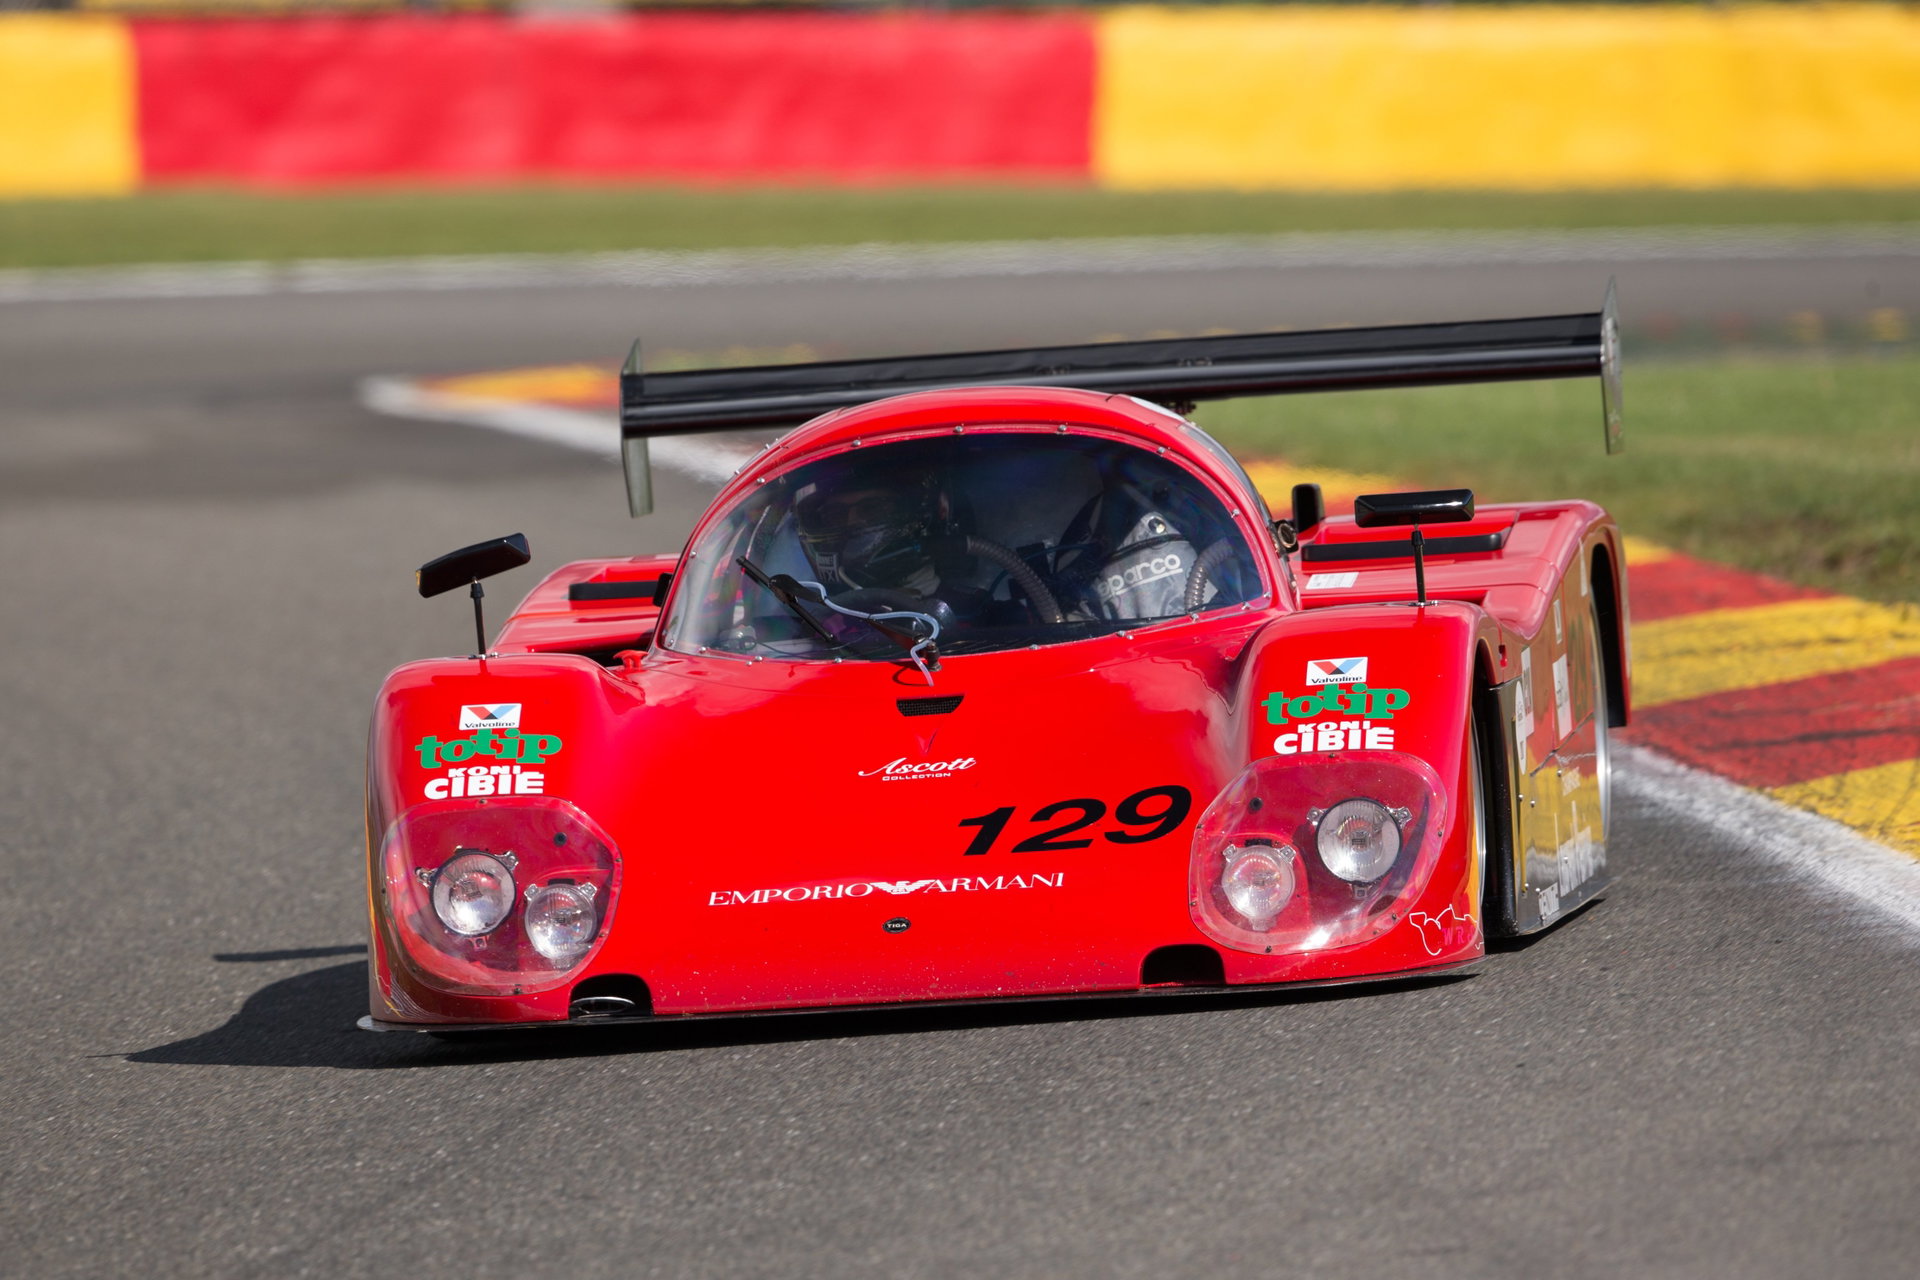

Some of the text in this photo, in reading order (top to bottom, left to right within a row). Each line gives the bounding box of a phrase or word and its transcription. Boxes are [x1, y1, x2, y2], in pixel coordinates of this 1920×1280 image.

[1311, 676, 1363, 684] Valvoline
[1261, 683, 1411, 724] totip
[464, 721, 516, 729] Valvoline
[1297, 720, 1371, 734] KONI
[414, 728, 563, 769] totip
[448, 764, 521, 778] KONI
[858, 757, 977, 777] Ascott
[882, 772, 951, 781] COLLECTION
[958, 784, 1192, 856] 129
[708, 872, 1064, 906] EMPORIO ARMANI
